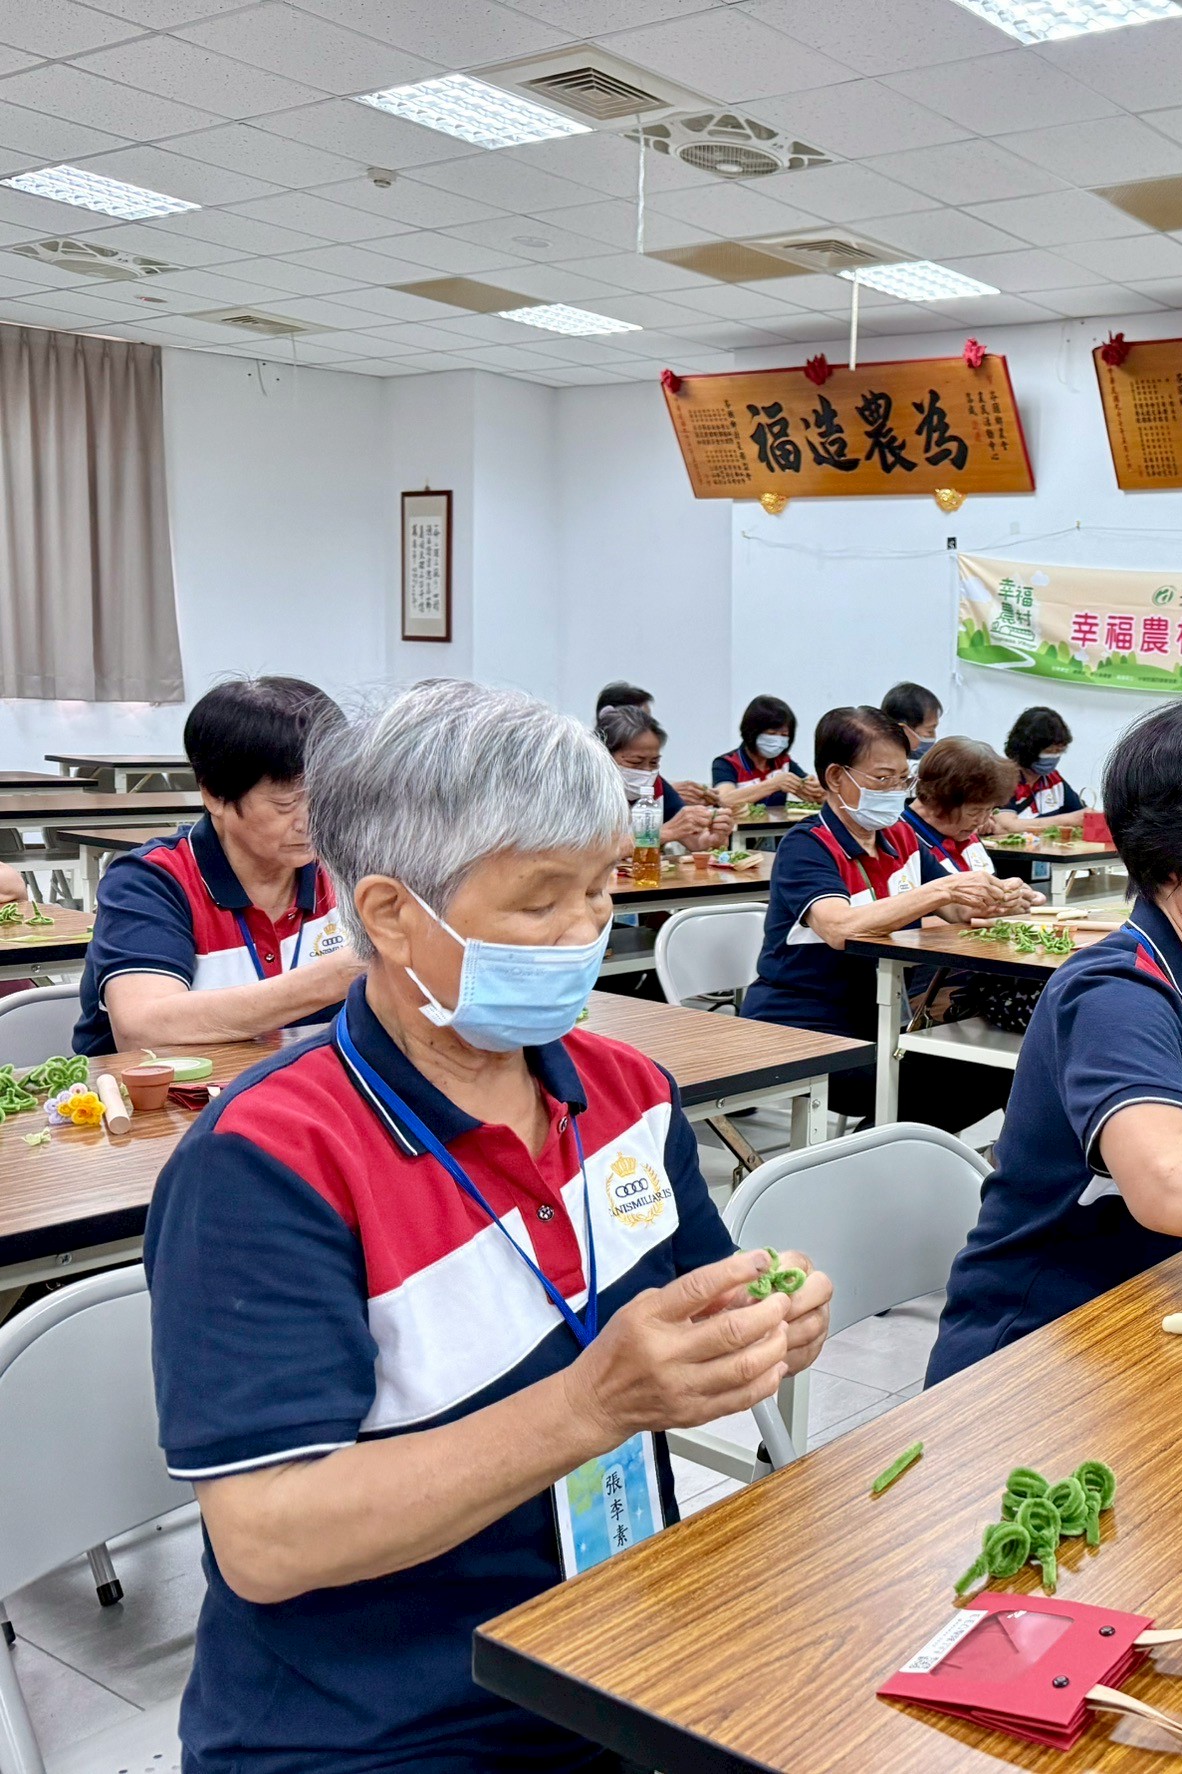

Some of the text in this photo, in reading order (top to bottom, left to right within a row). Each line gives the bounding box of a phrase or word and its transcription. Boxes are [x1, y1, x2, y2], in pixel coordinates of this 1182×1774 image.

[609, 1187, 672, 1217] ANISMILIARIS
[606, 1471, 628, 1550] 張李素
